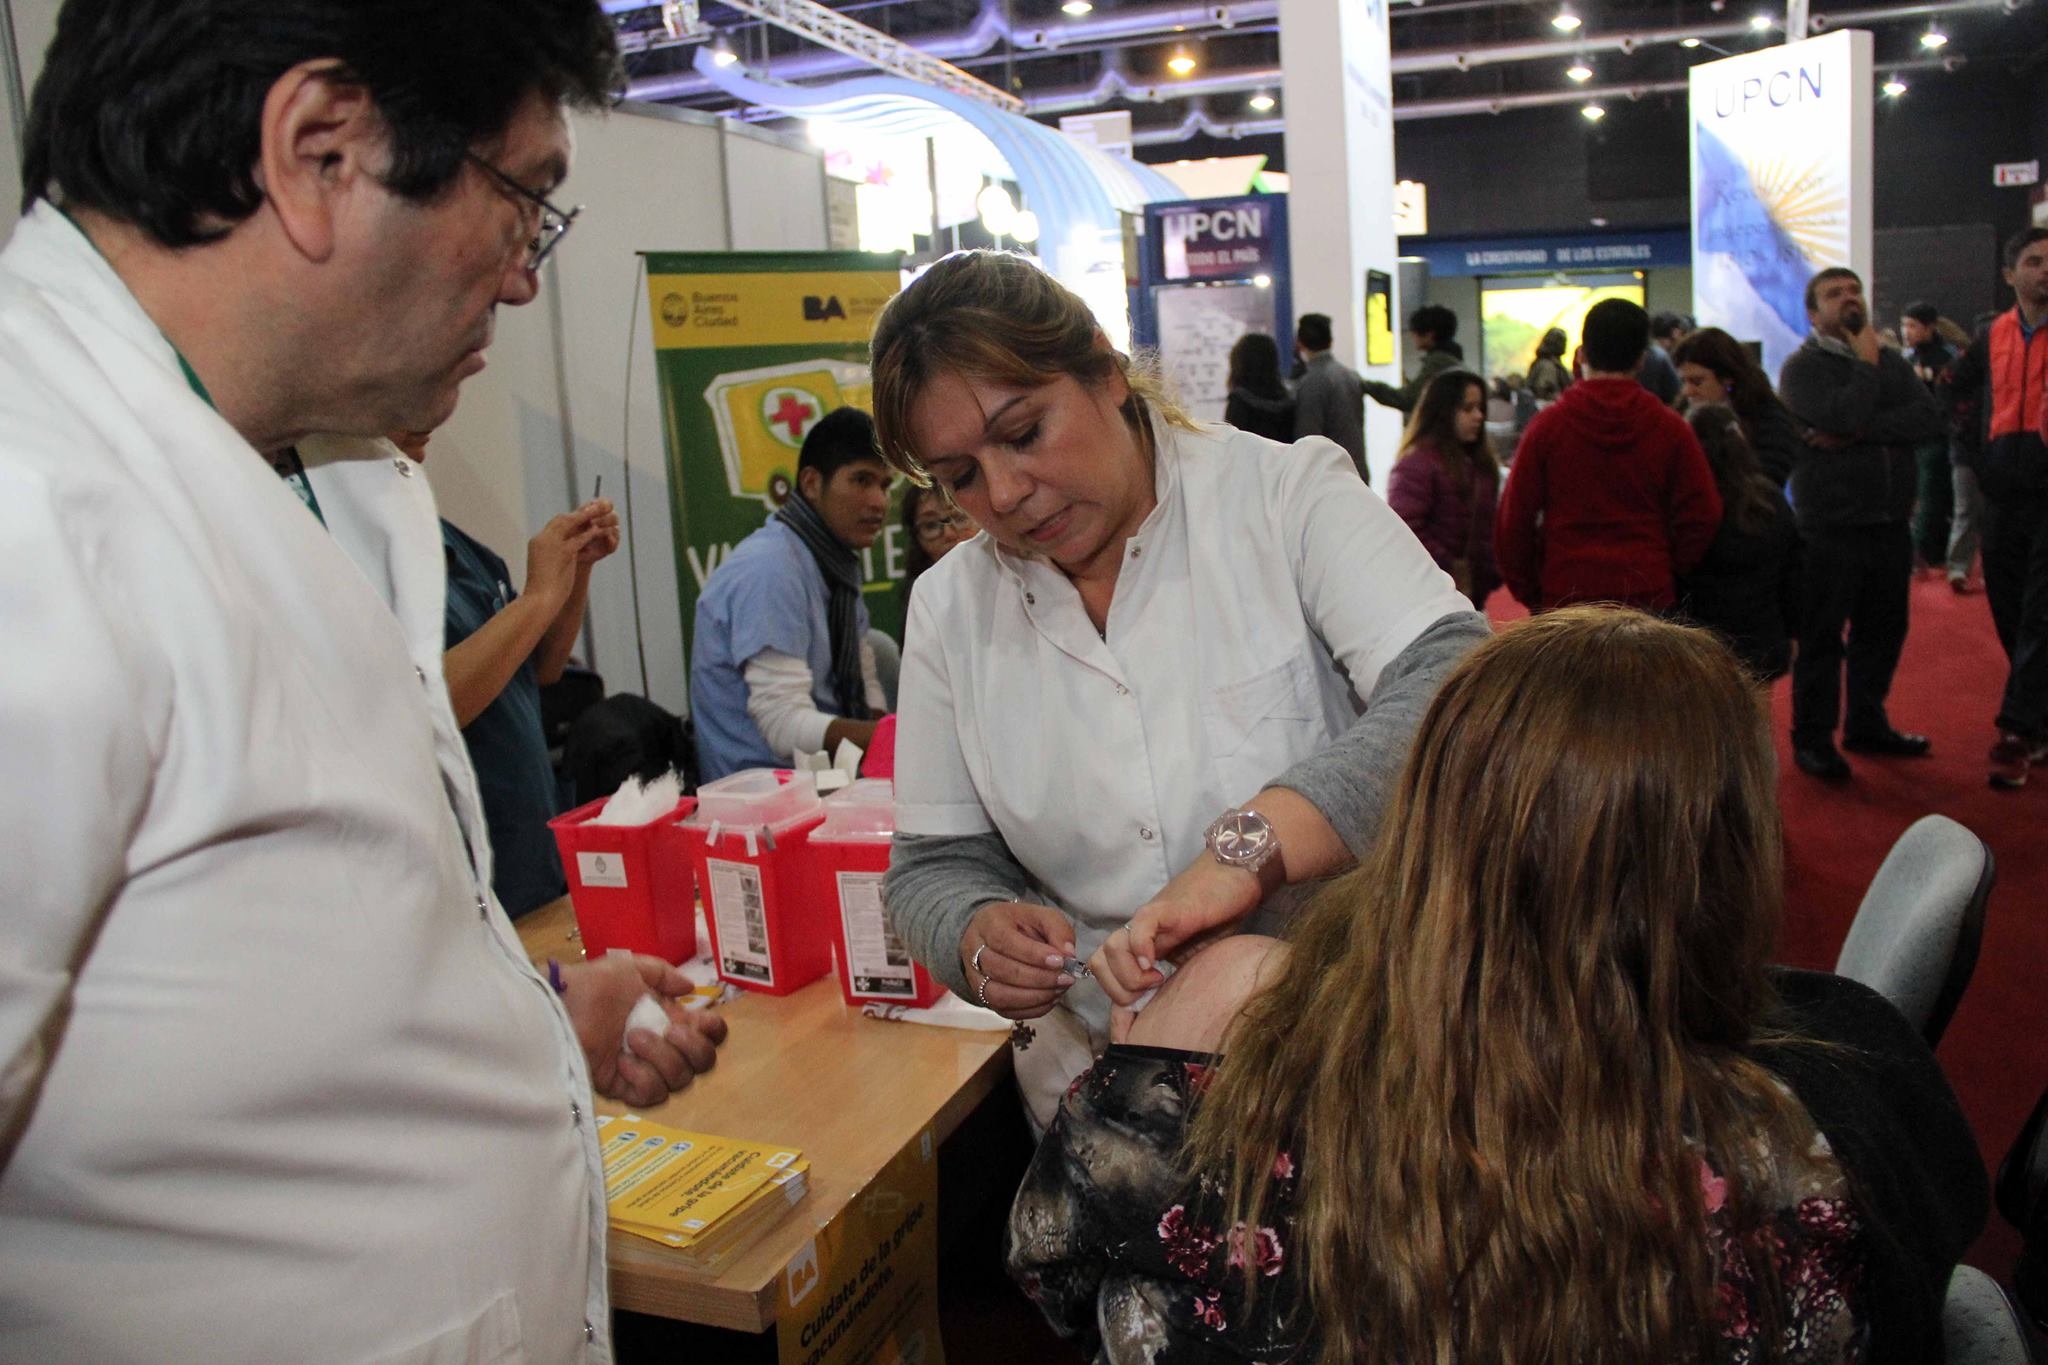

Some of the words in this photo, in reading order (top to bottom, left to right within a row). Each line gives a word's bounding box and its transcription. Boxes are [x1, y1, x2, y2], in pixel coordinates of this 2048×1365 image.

[1715, 62, 1822, 119] UPCN
[1163, 207, 1262, 243] UPCN
[802, 295, 847, 321] BA
[800, 1277, 857, 1348] Cuidate
[859, 1255, 877, 1283] de
[878, 1239, 891, 1263] la
